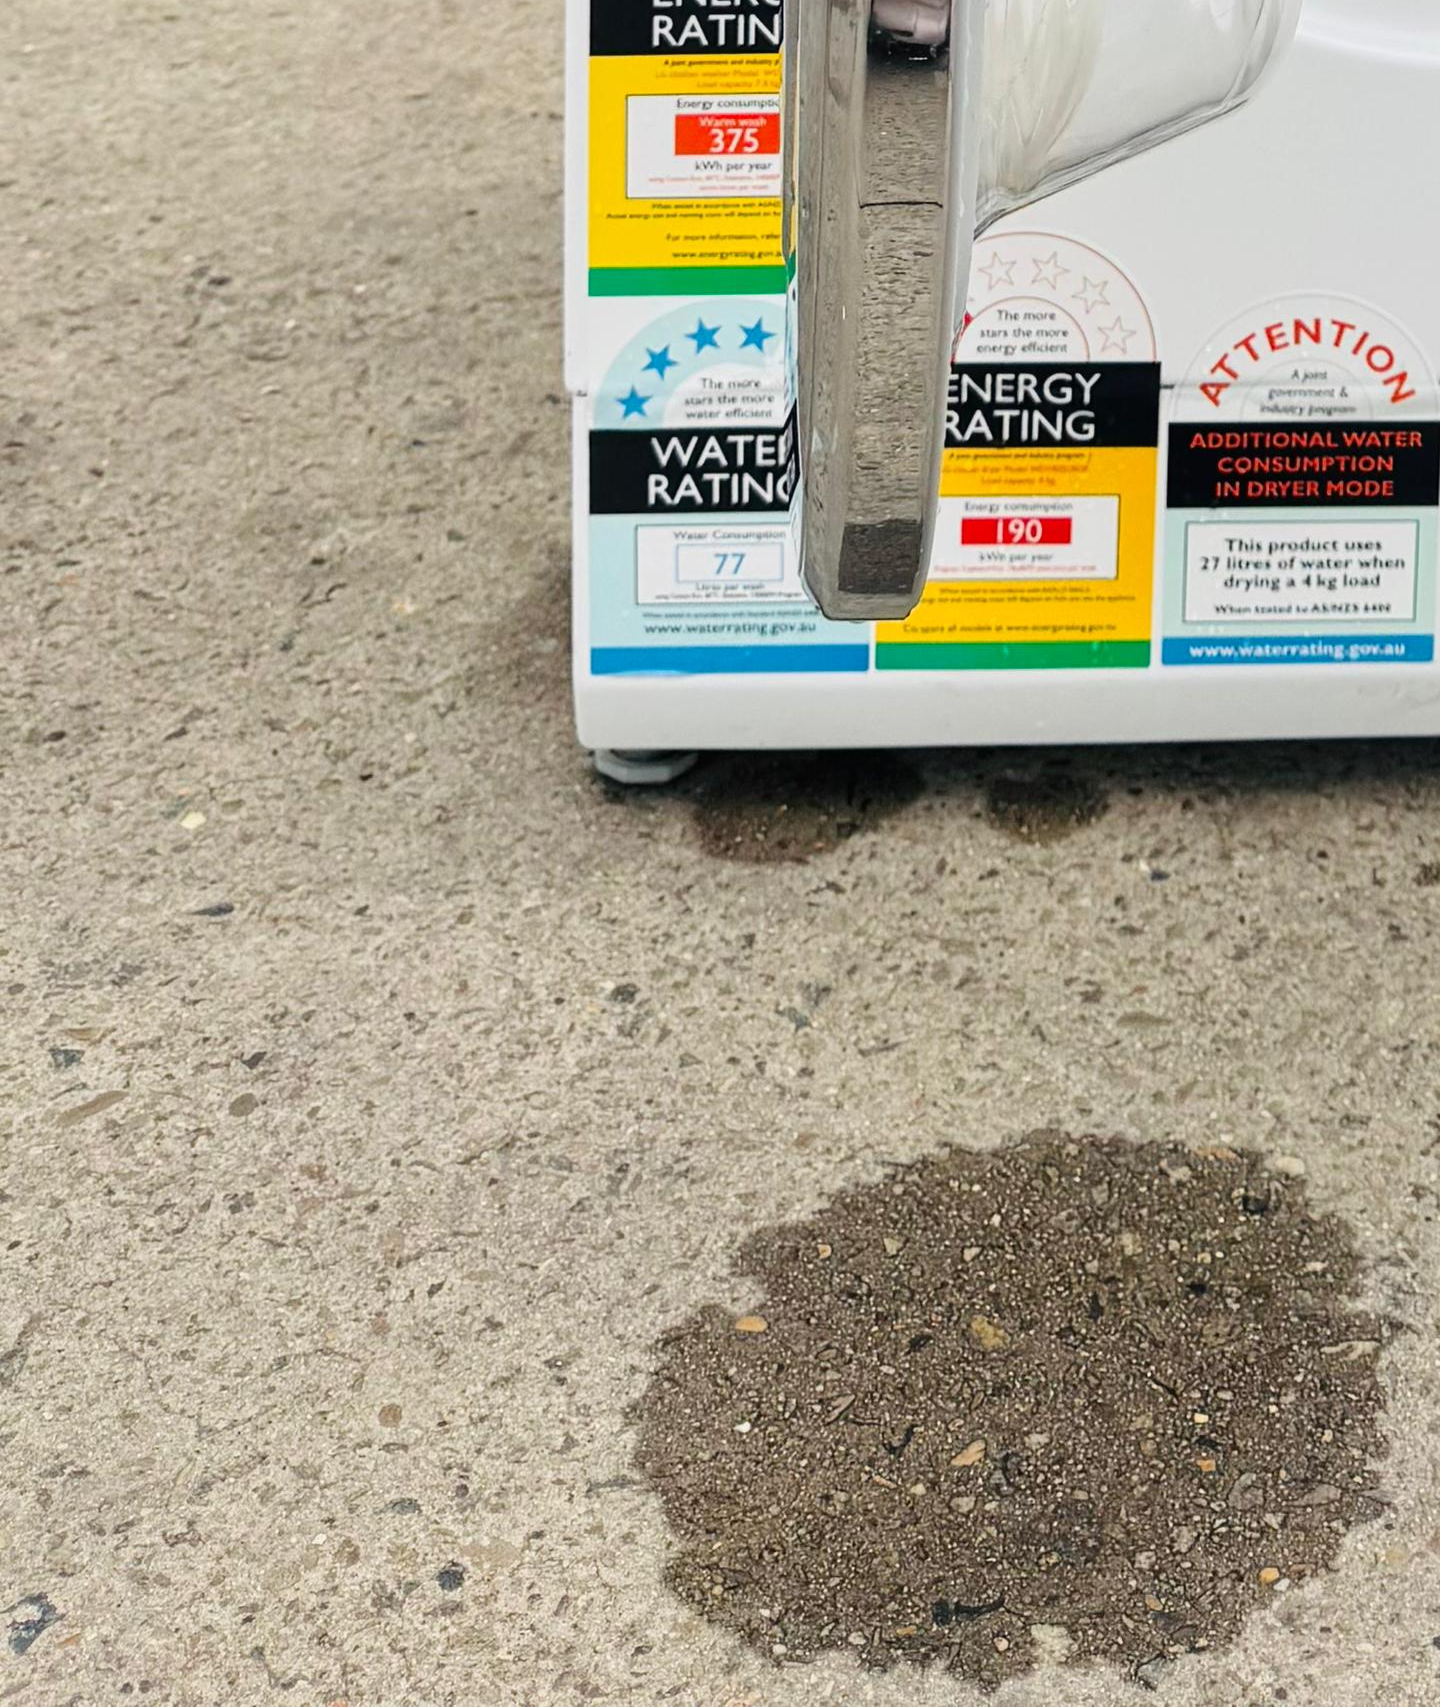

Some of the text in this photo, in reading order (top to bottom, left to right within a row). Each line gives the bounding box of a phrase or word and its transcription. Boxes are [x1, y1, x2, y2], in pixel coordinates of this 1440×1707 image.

[652, 13, 780, 47] RATIN
[676, 98, 714, 110] Energy
[699, 116, 767, 127] Warm wash
[709, 128, 760, 153] 375
[695, 161, 773, 173] kWh per year
[997, 309, 1056, 321] The more
[980, 327, 1069, 338] stars the more
[977, 342, 1068, 356] energy efficient
[1198, 318, 1416, 407] ATTENTION
[1291, 369, 1328, 383] A joint
[701, 378, 762, 389] The more
[947, 372, 1101, 406] ENERGY
[684, 394, 775, 405] stars the more
[1268, 387, 1348, 400] government &
[686, 407, 773, 419] water efficient
[1260, 404, 1357, 416] industry program
[944, 409, 1096, 442] RATING
[1190, 431, 1423, 449] ADDITIONAL WATER
[1217, 455, 1394, 474] CONSUMPTION
[1215, 480, 1395, 497] IN DRYER MODE
[965, 501, 1073, 513] Energy consumption
[673, 528, 787, 541] Water Consumption
[996, 518, 1043, 543] 190
[1225, 538, 1382, 556] This product uses
[714, 552, 746, 575] 77
[1009, 553, 1026, 563] per
[1031, 553, 1054, 563] year
[1200, 555, 1406, 571] 27 litres of water when
[1224, 574, 1381, 593] drying a 4 kg load
[1214, 603, 1251, 614] When
[644, 620, 817, 635] www.waterrating.gov.au
[1189, 639, 1406, 660] www.waterrating.gov.au
